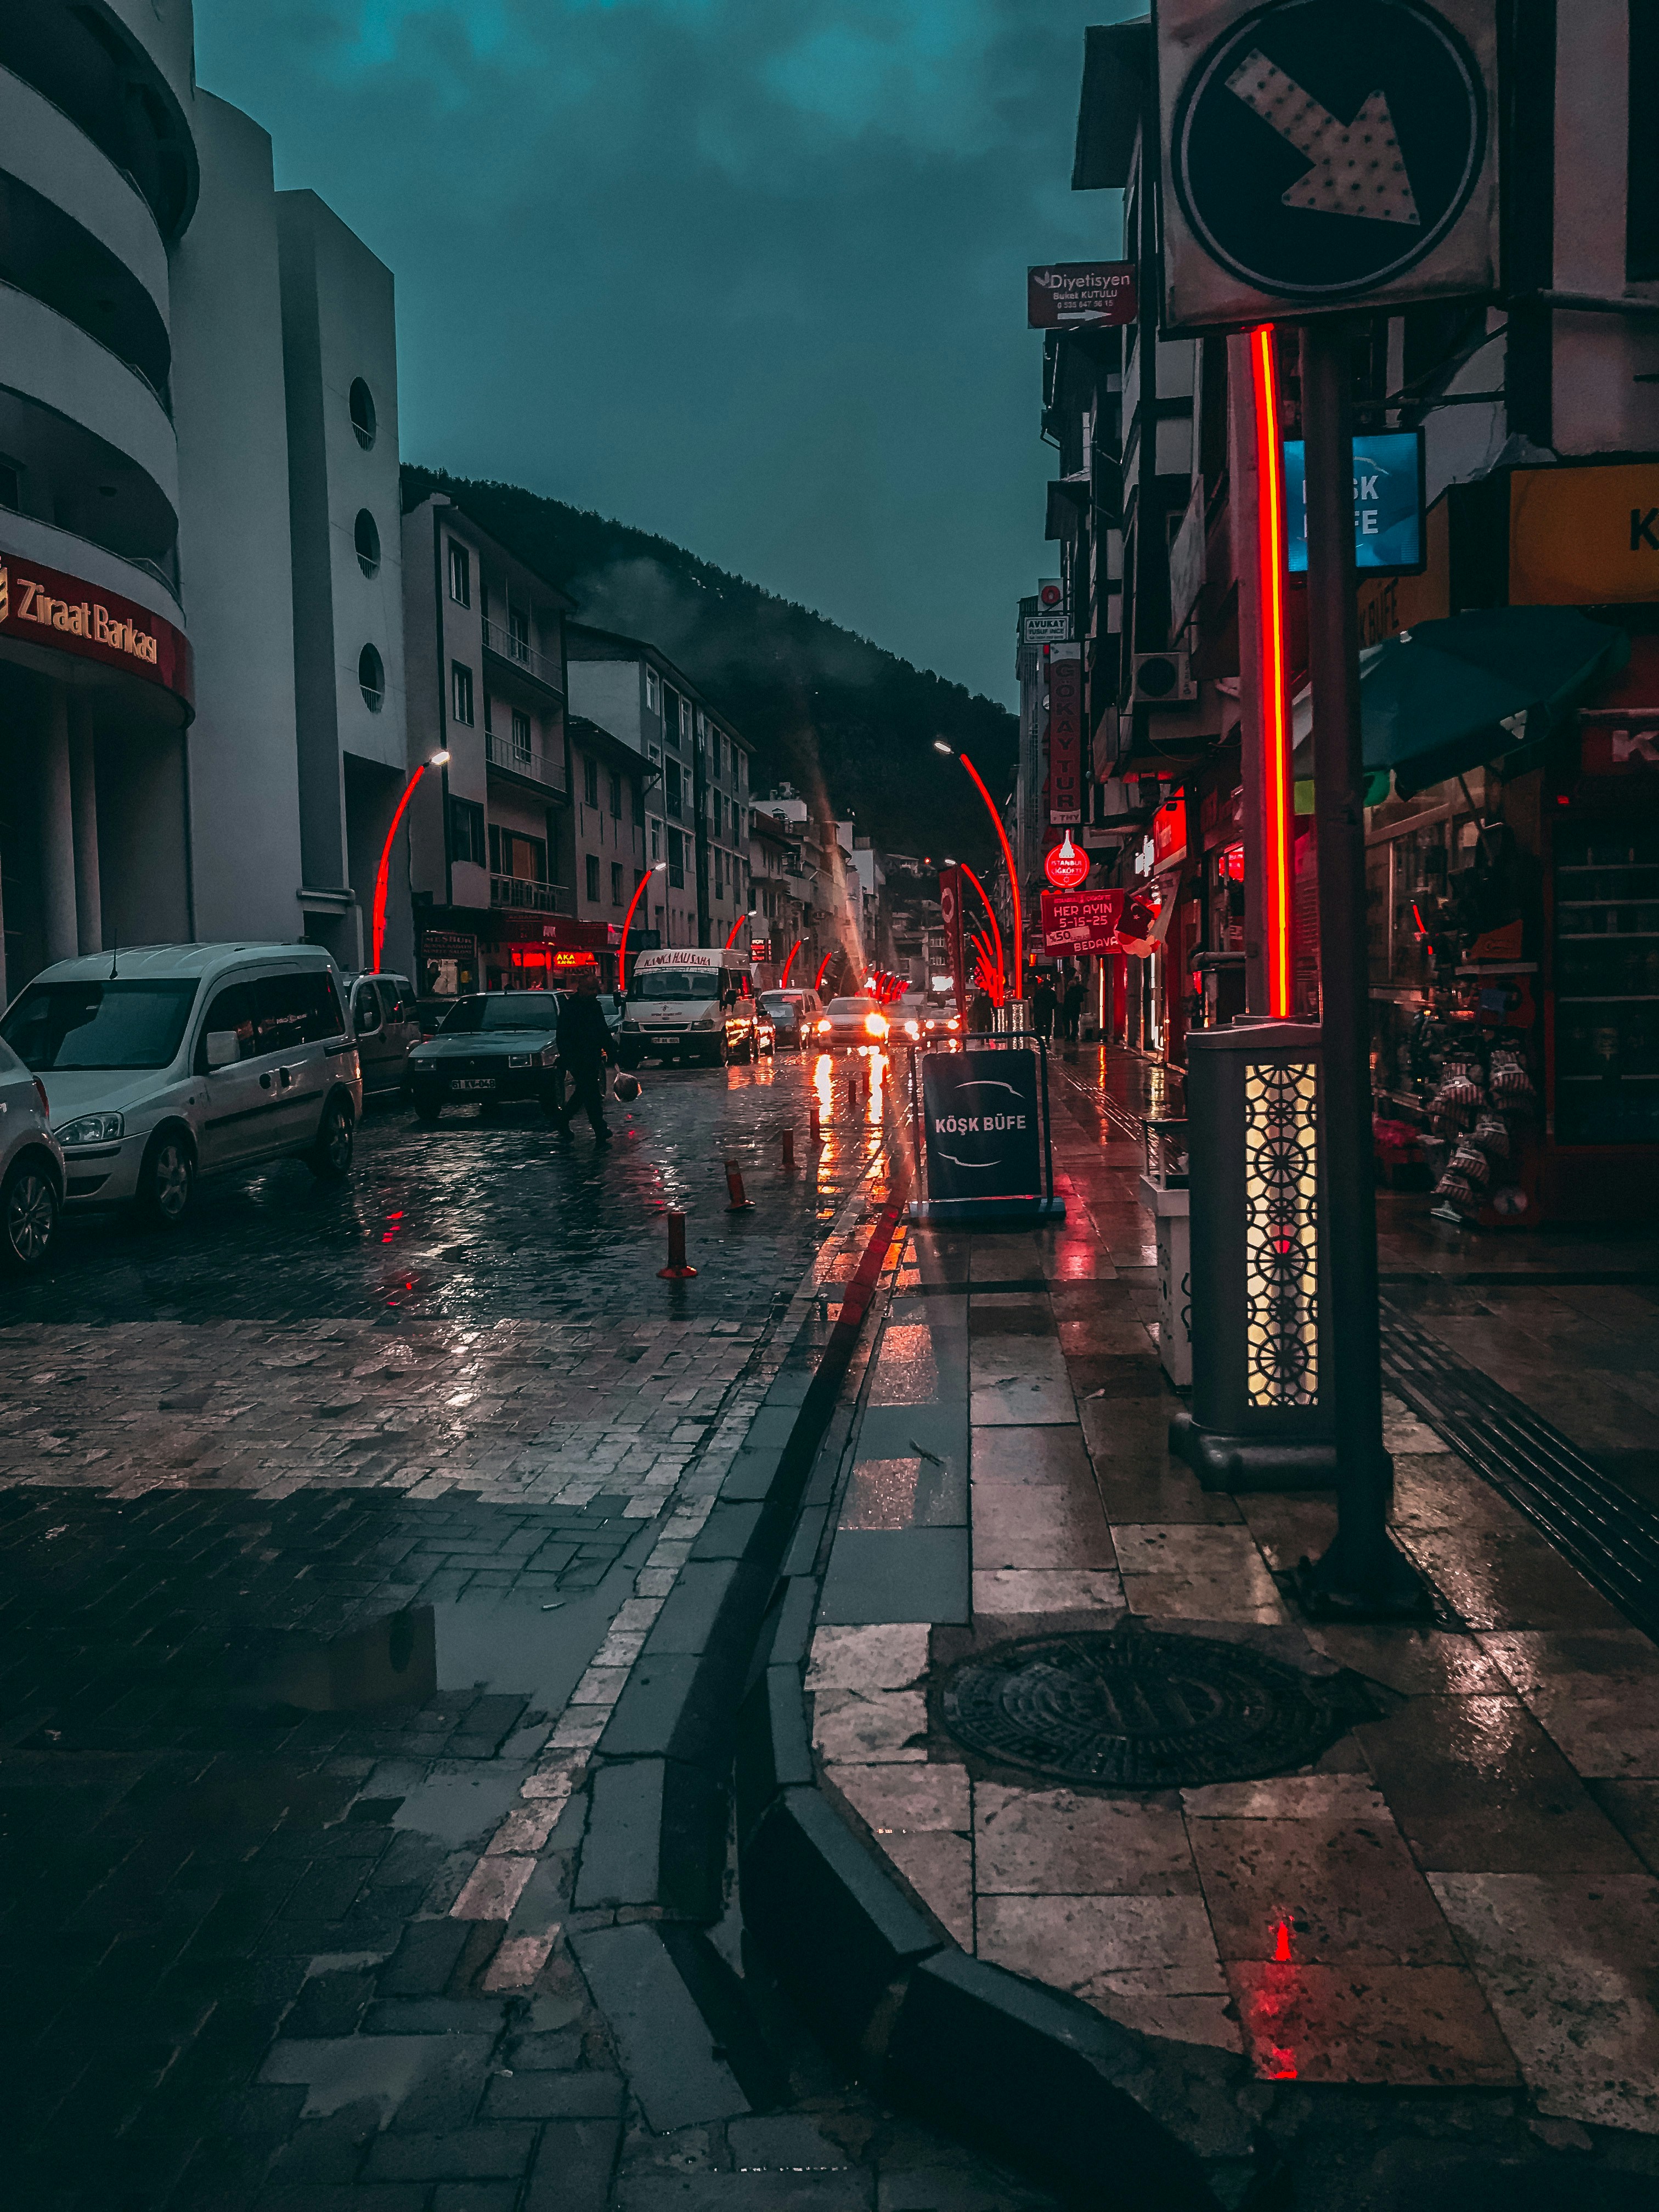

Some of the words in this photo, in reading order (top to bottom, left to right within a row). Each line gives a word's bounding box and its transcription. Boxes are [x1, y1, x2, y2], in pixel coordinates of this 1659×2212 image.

[1049, 273, 1130, 291] Diyetisyen
[1053, 292, 1079, 300] Buket
[1081, 290, 1118, 298] KUTULU
[16, 579, 92, 639] Ziraat
[94, 604, 157, 664] Bankası
[1028, 619, 1065, 628] AVUKAT
[1054, 662, 1075, 751] GÖKAY
[1056, 759, 1075, 808] TUR
[1054, 905, 1079, 917] HER
[1083, 903, 1112, 915] AYIN
[1059, 915, 1108, 928] 5-15-25
[1074, 936, 1119, 952] BEDAVA
[935, 1115, 979, 1136] KÖŞK
[983, 1113, 1026, 1131] BÜFE
